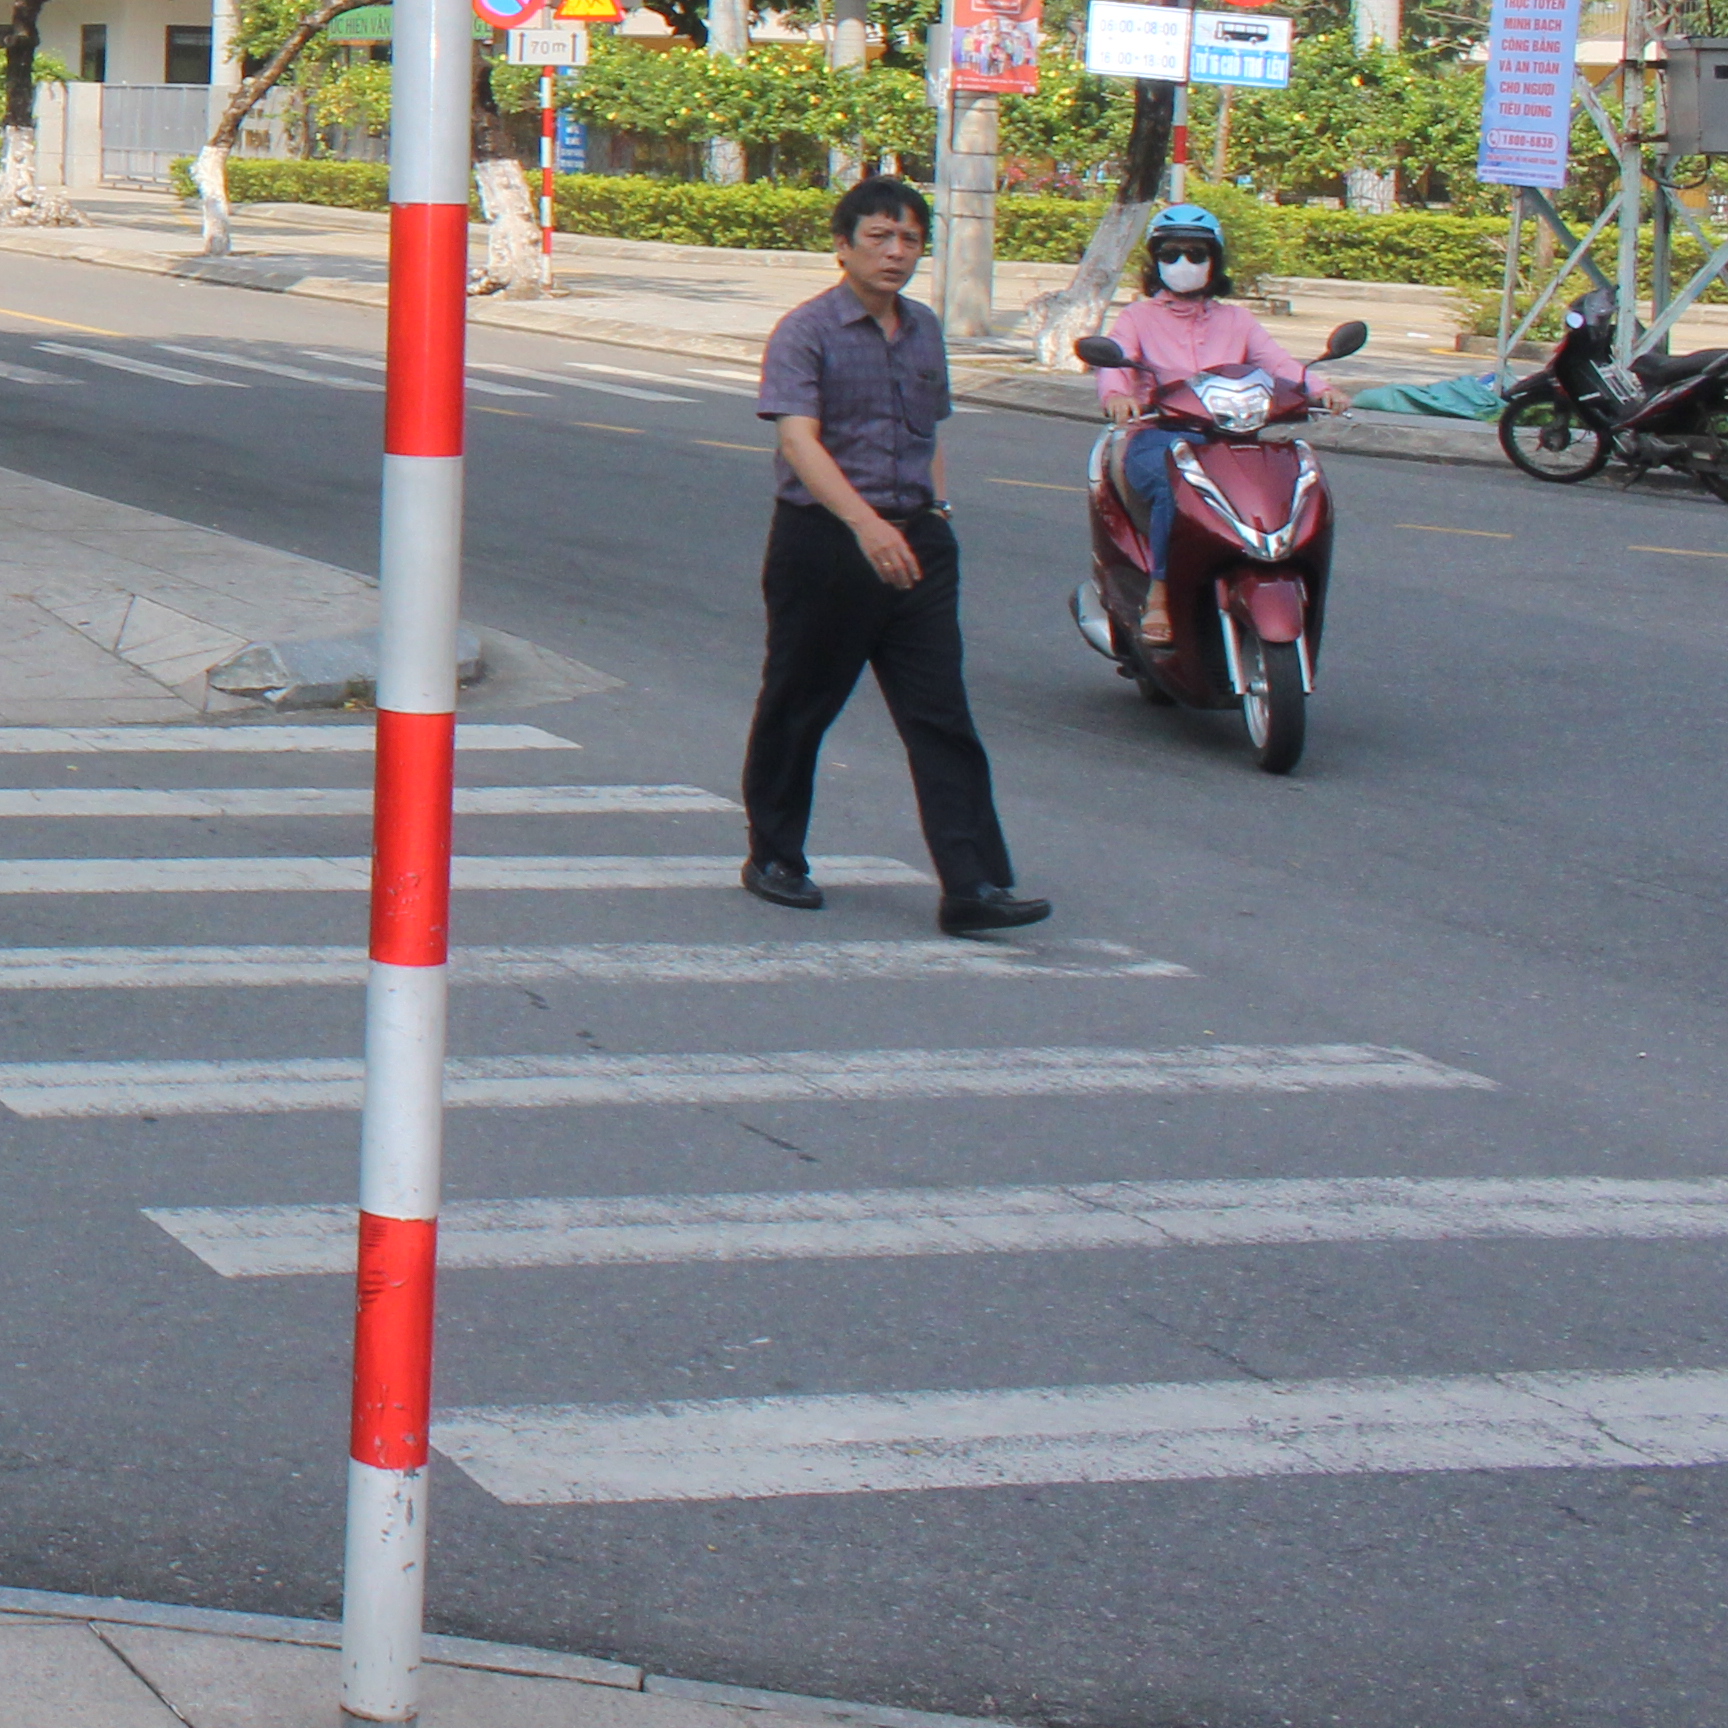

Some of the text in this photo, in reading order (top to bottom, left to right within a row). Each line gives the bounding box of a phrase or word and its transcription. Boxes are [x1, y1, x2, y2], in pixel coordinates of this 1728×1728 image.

[1503, 17, 1531, 31] MINH
[1501, 37, 1530, 52] CÔNG
[1499, 58, 1559, 74] VÀ AN TOÀN
[1499, 81, 1520, 93] CHO
